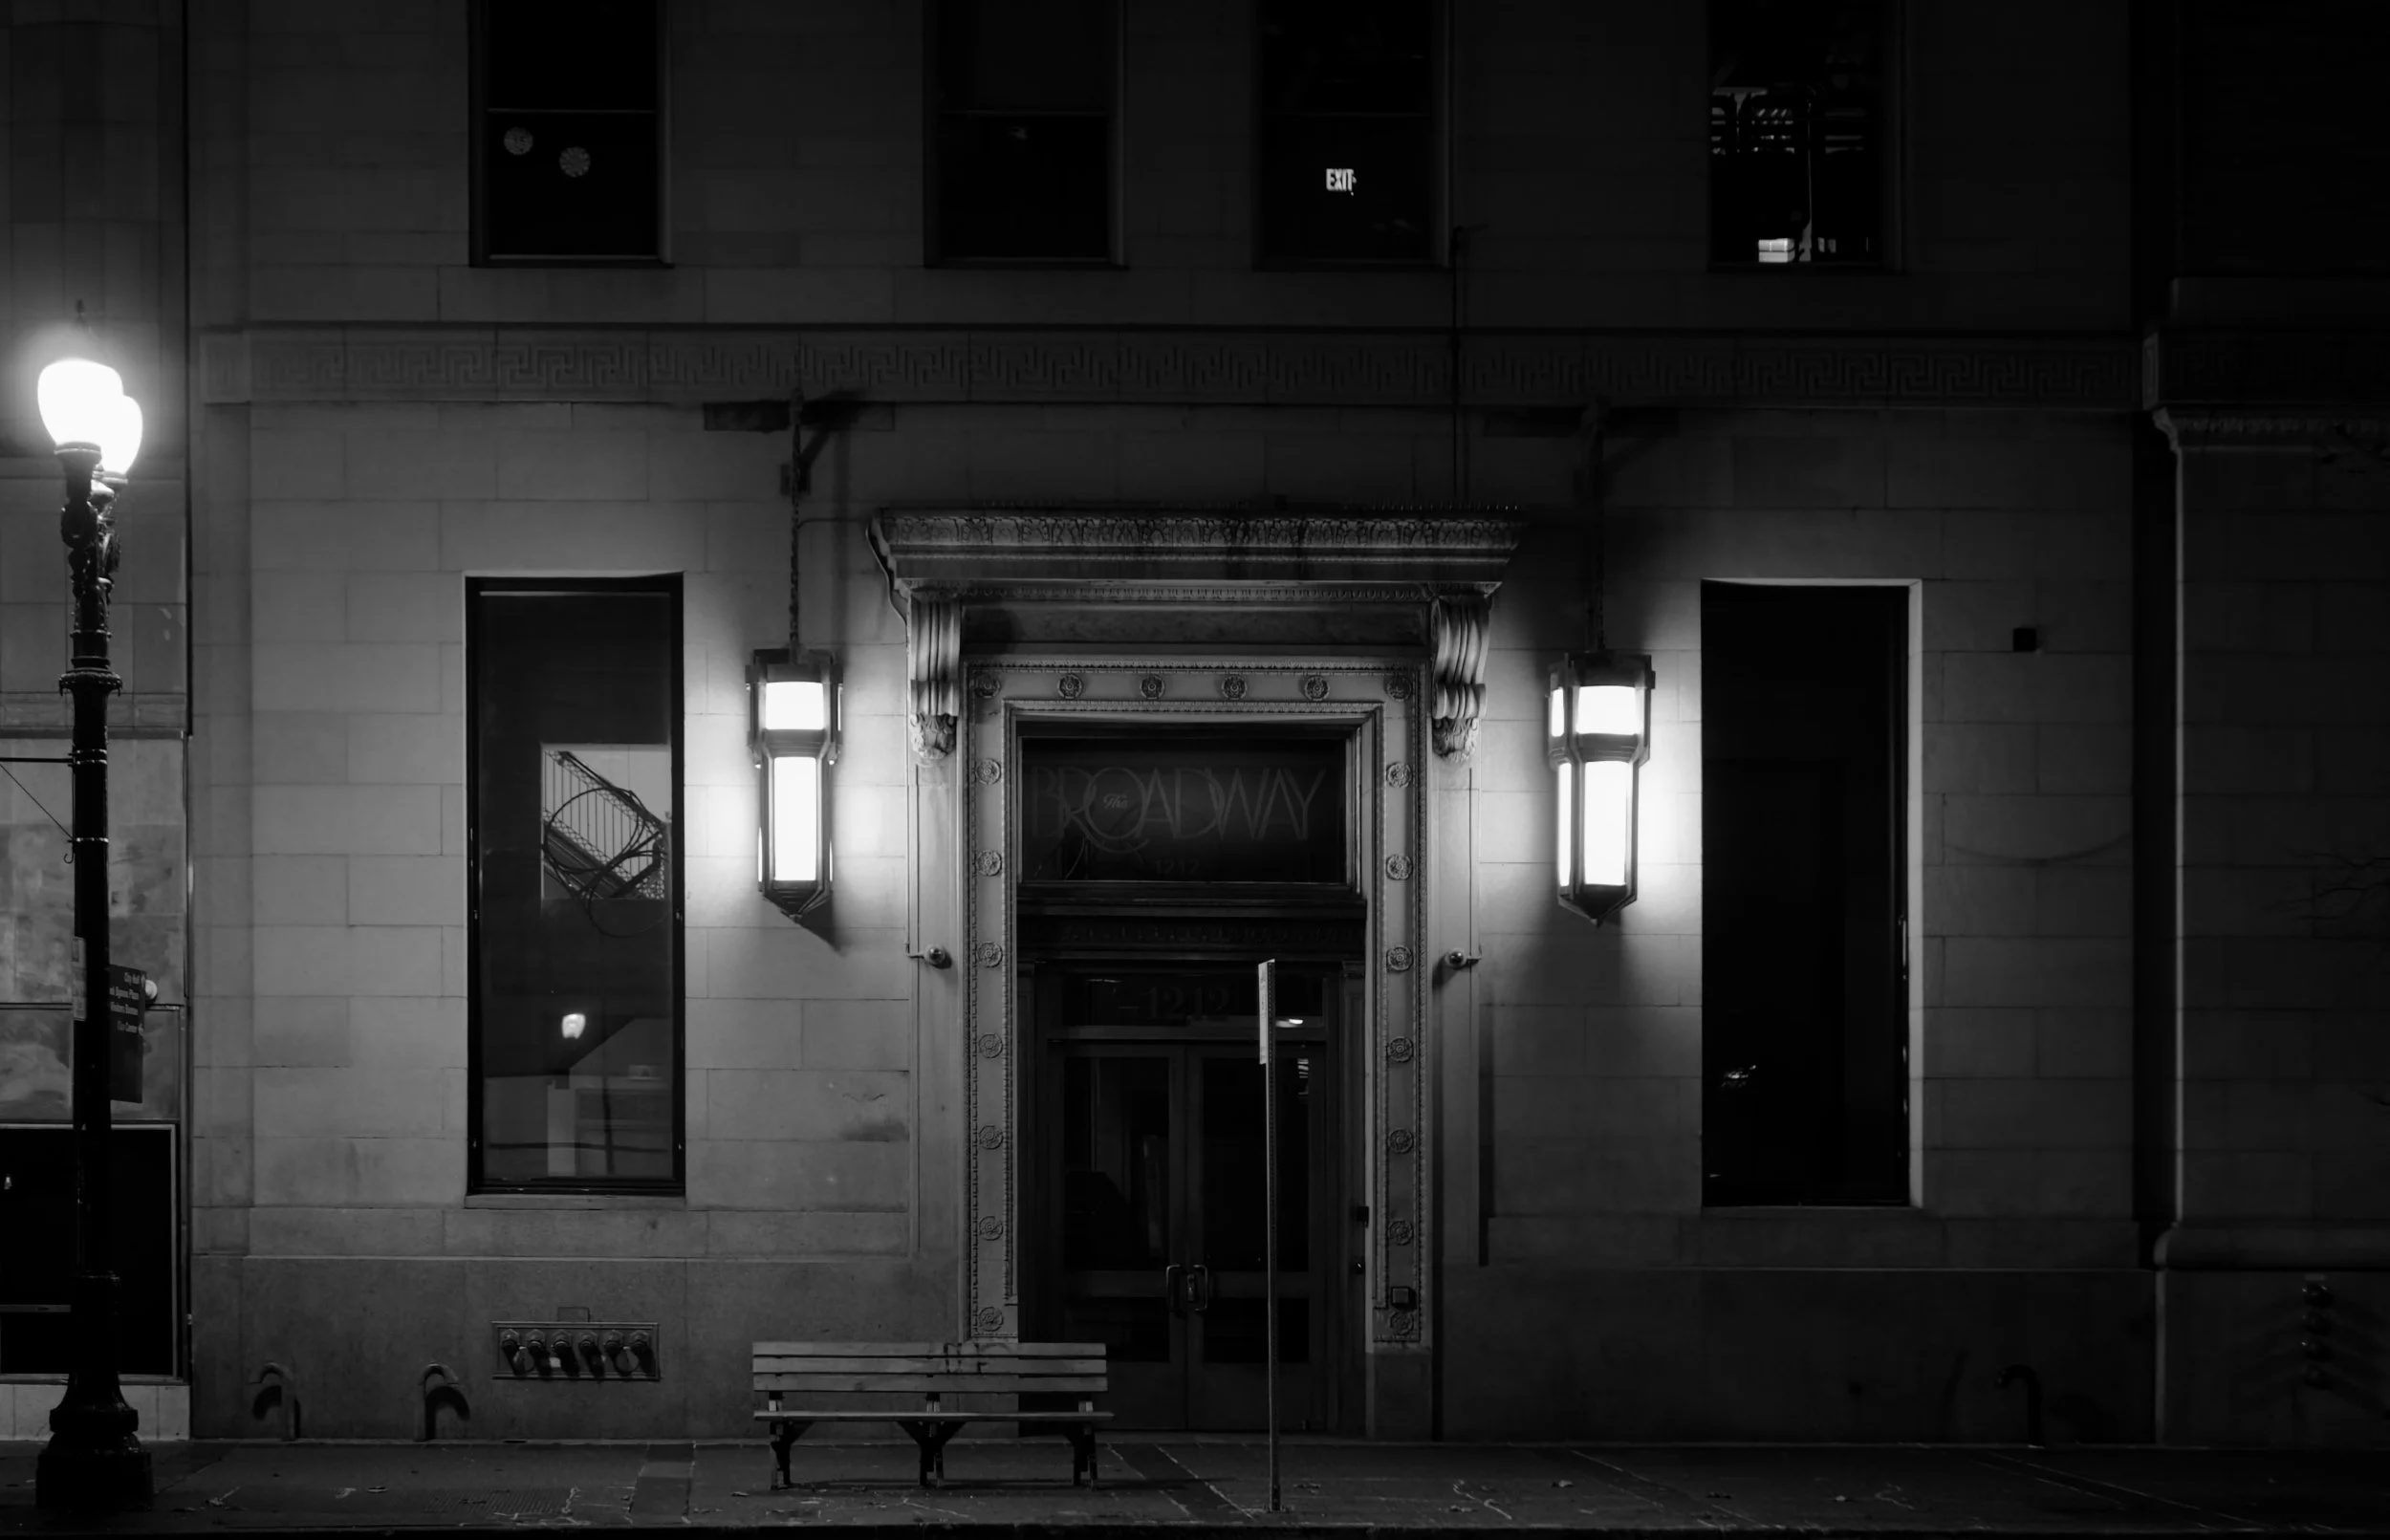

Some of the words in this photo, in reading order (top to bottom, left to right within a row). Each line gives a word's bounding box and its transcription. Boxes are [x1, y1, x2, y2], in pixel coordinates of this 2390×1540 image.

[1326, 168, 1354, 192] EXIT
[1032, 766, 1326, 854] BROADWAY
[1102, 793, 1129, 810] The
[1141, 985, 1229, 1025] 1212
